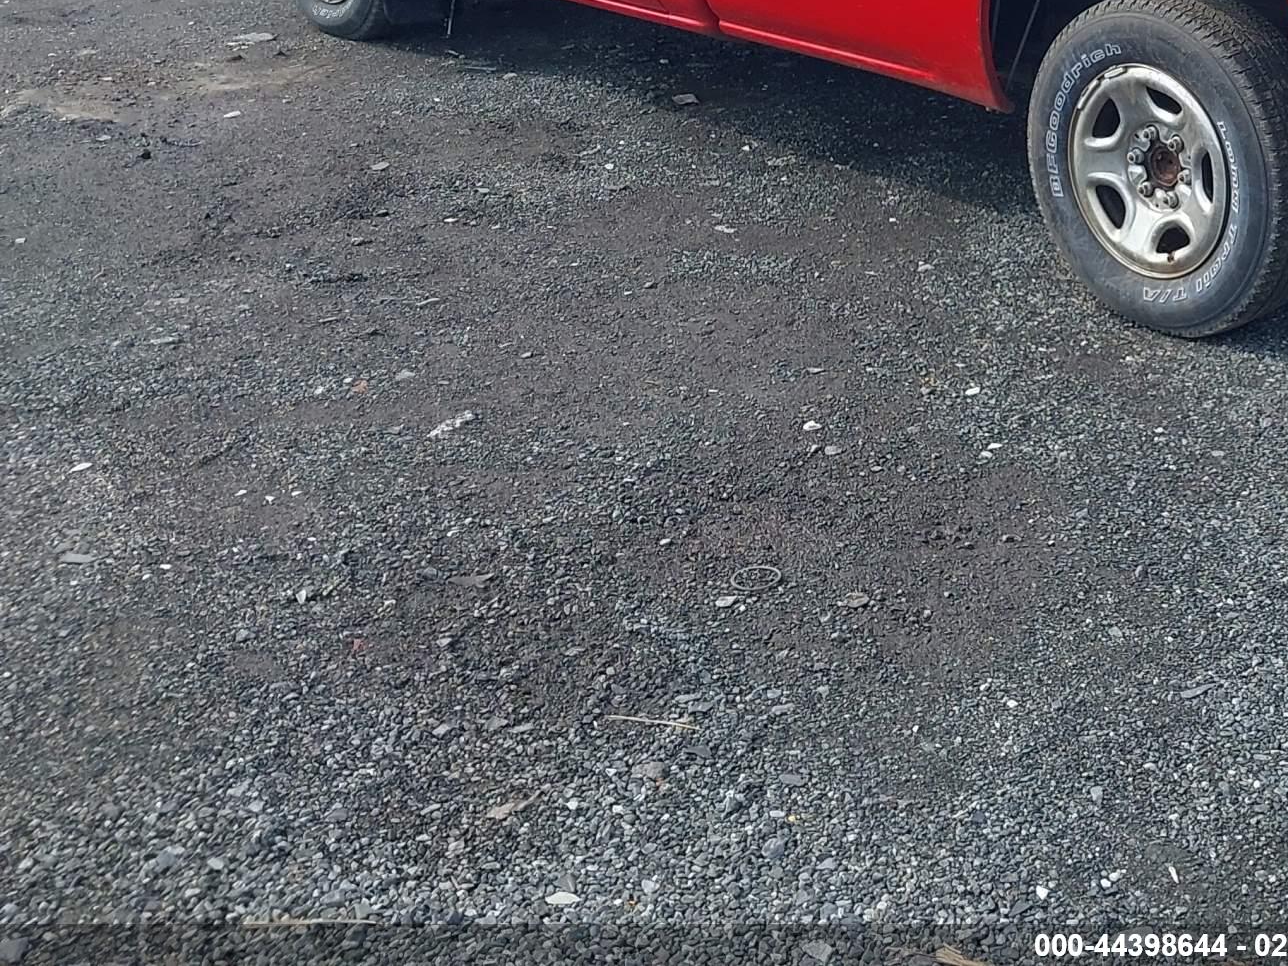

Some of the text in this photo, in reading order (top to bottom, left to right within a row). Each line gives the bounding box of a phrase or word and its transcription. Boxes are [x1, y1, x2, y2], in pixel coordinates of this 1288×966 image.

[1045, 42, 1123, 198] BFGoodrich
[1194, 222, 1239, 293] Trail
[1142, 286, 1188, 304] T/A
